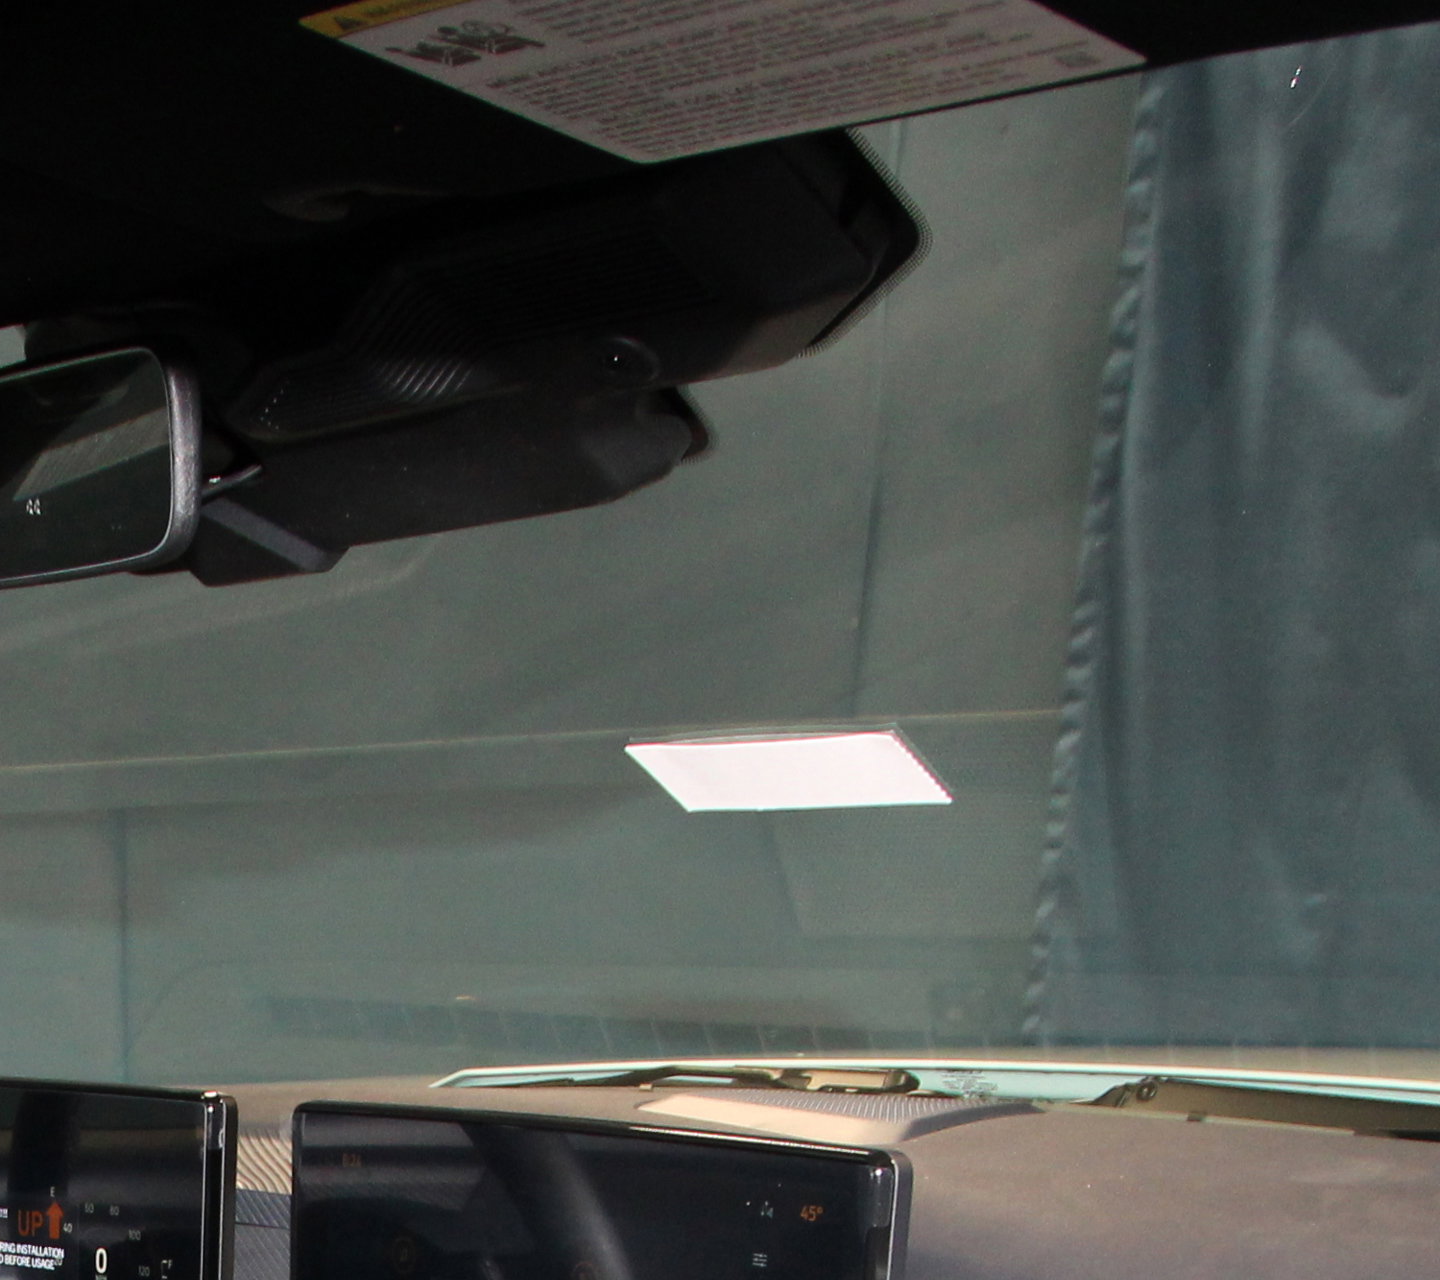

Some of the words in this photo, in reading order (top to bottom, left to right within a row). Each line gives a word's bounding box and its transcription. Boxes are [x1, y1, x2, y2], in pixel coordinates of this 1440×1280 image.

[18, 1209, 44, 1237] UP
[4, 1253, 31, 1267] BEFORE
[16, 1243, 64, 1258] INSTALLATION
[95, 1248, 108, 1274] 0
